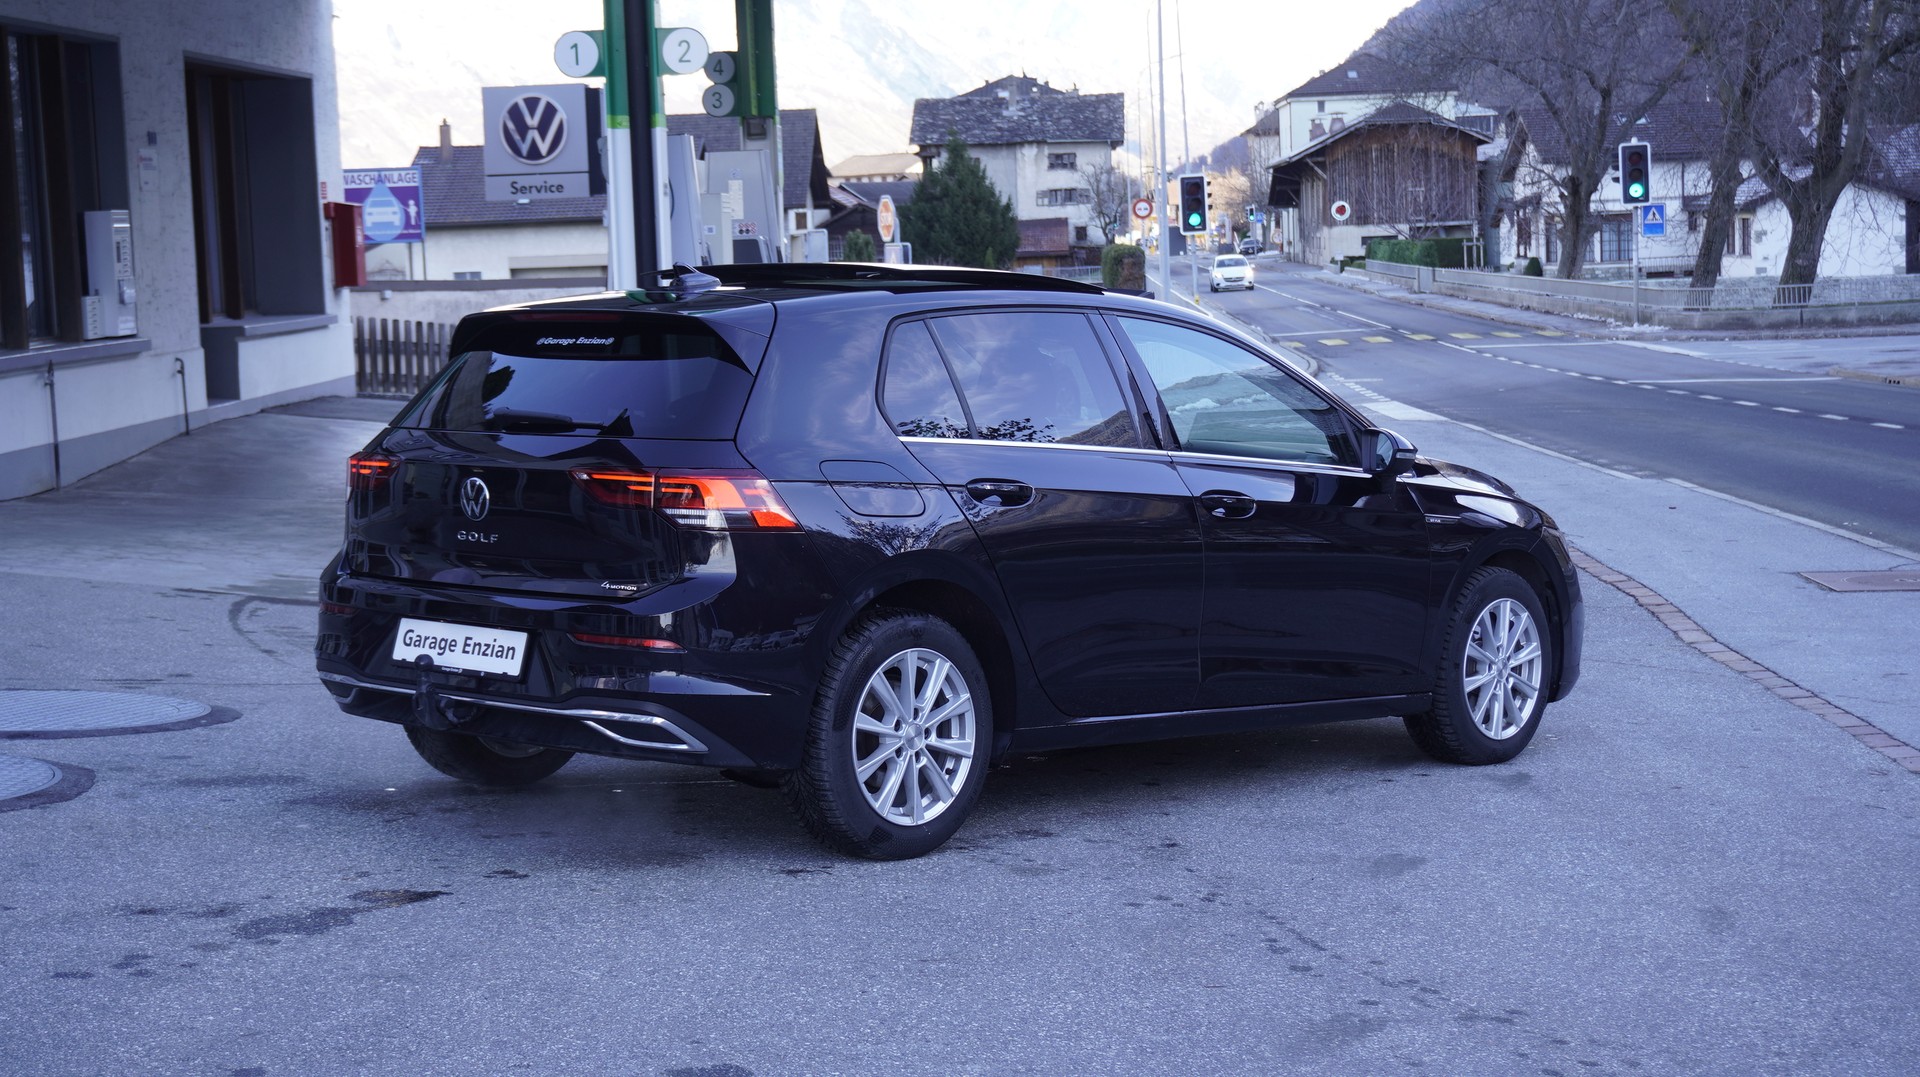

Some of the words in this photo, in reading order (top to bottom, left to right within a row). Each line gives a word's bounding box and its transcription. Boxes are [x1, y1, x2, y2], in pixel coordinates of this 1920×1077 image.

[570, 43, 580, 66] 1
[678, 40, 692, 63] 2
[713, 59, 724, 76] 4
[711, 92, 723, 109] 3
[502, 95, 565, 159] VW
[510, 180, 565, 195] Service
[461, 478, 489, 520] VW
[457, 530, 499, 543] GOLF
[402, 628, 458, 656] Garage
[461, 636, 516, 660] Enzian
